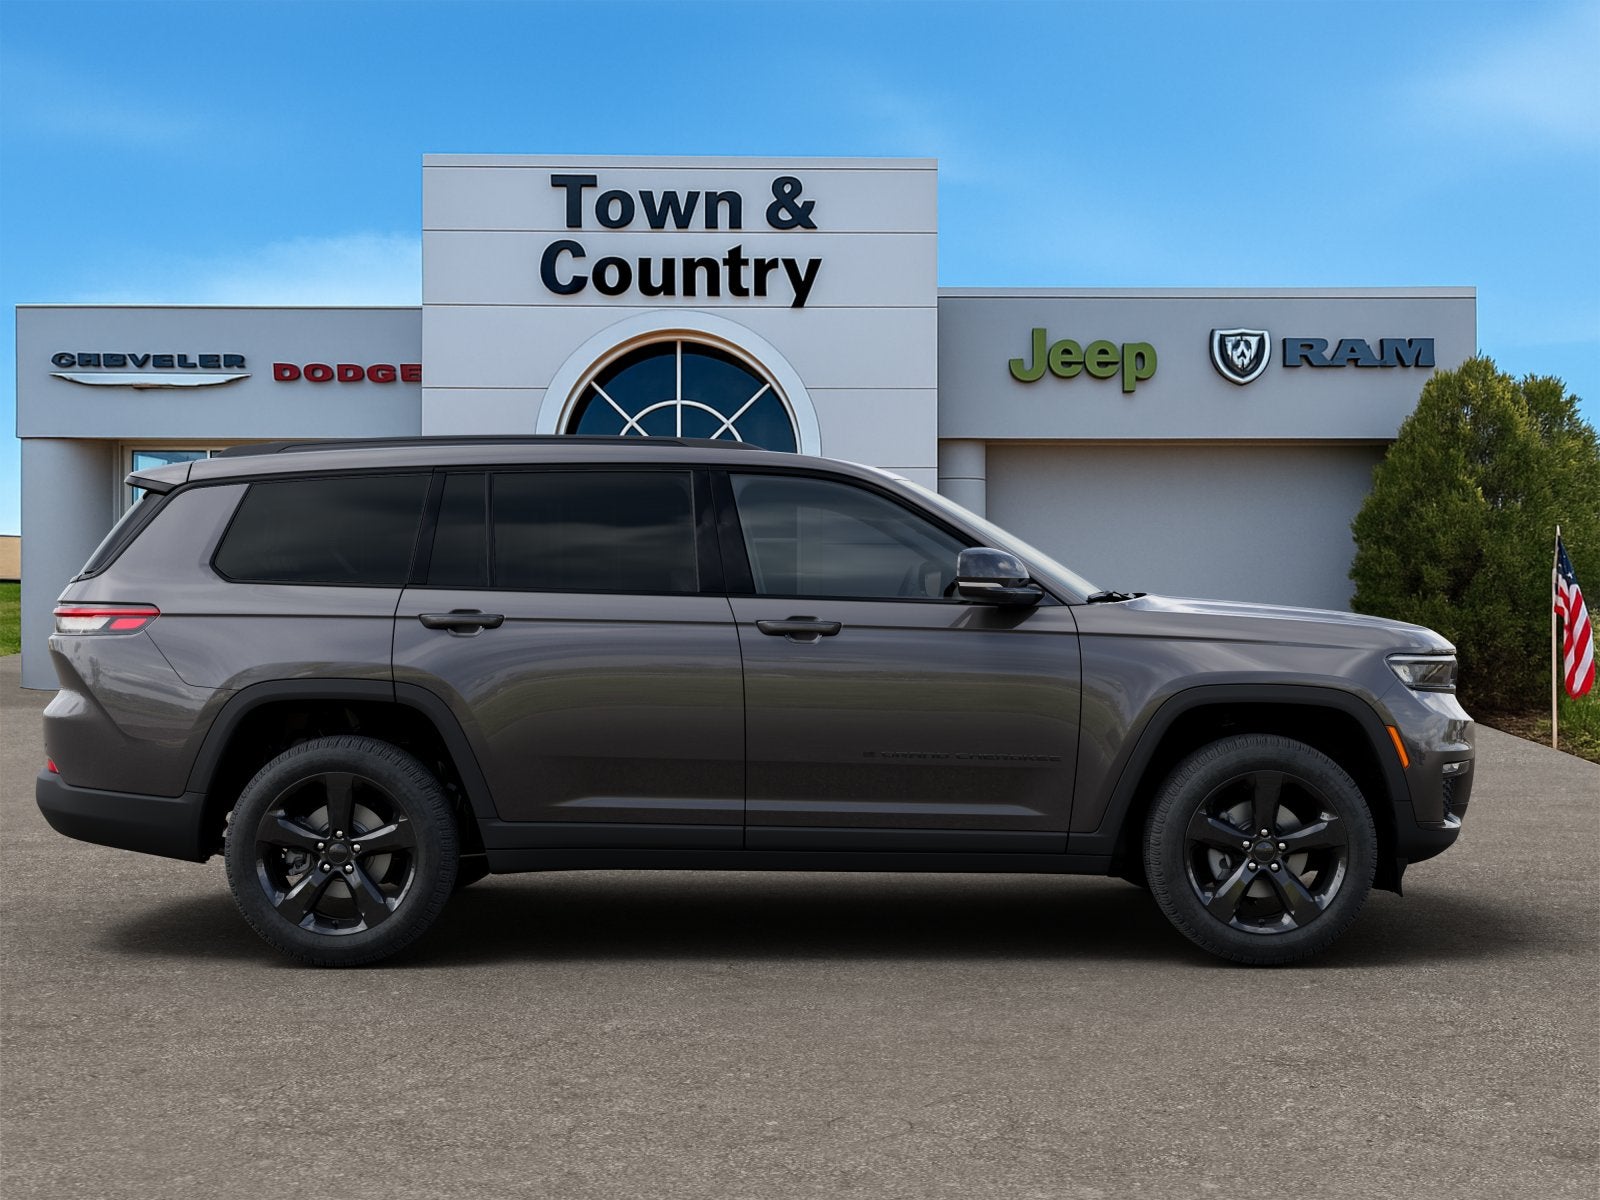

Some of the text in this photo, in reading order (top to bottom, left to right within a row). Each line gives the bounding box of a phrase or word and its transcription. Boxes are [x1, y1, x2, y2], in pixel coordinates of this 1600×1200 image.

[550, 174, 818, 229] Town &
[540, 239, 822, 308] Country
[273, 363, 422, 383] DODGE
[1009, 328, 1158, 393] Jeep
[1282, 338, 1435, 367] RAM
